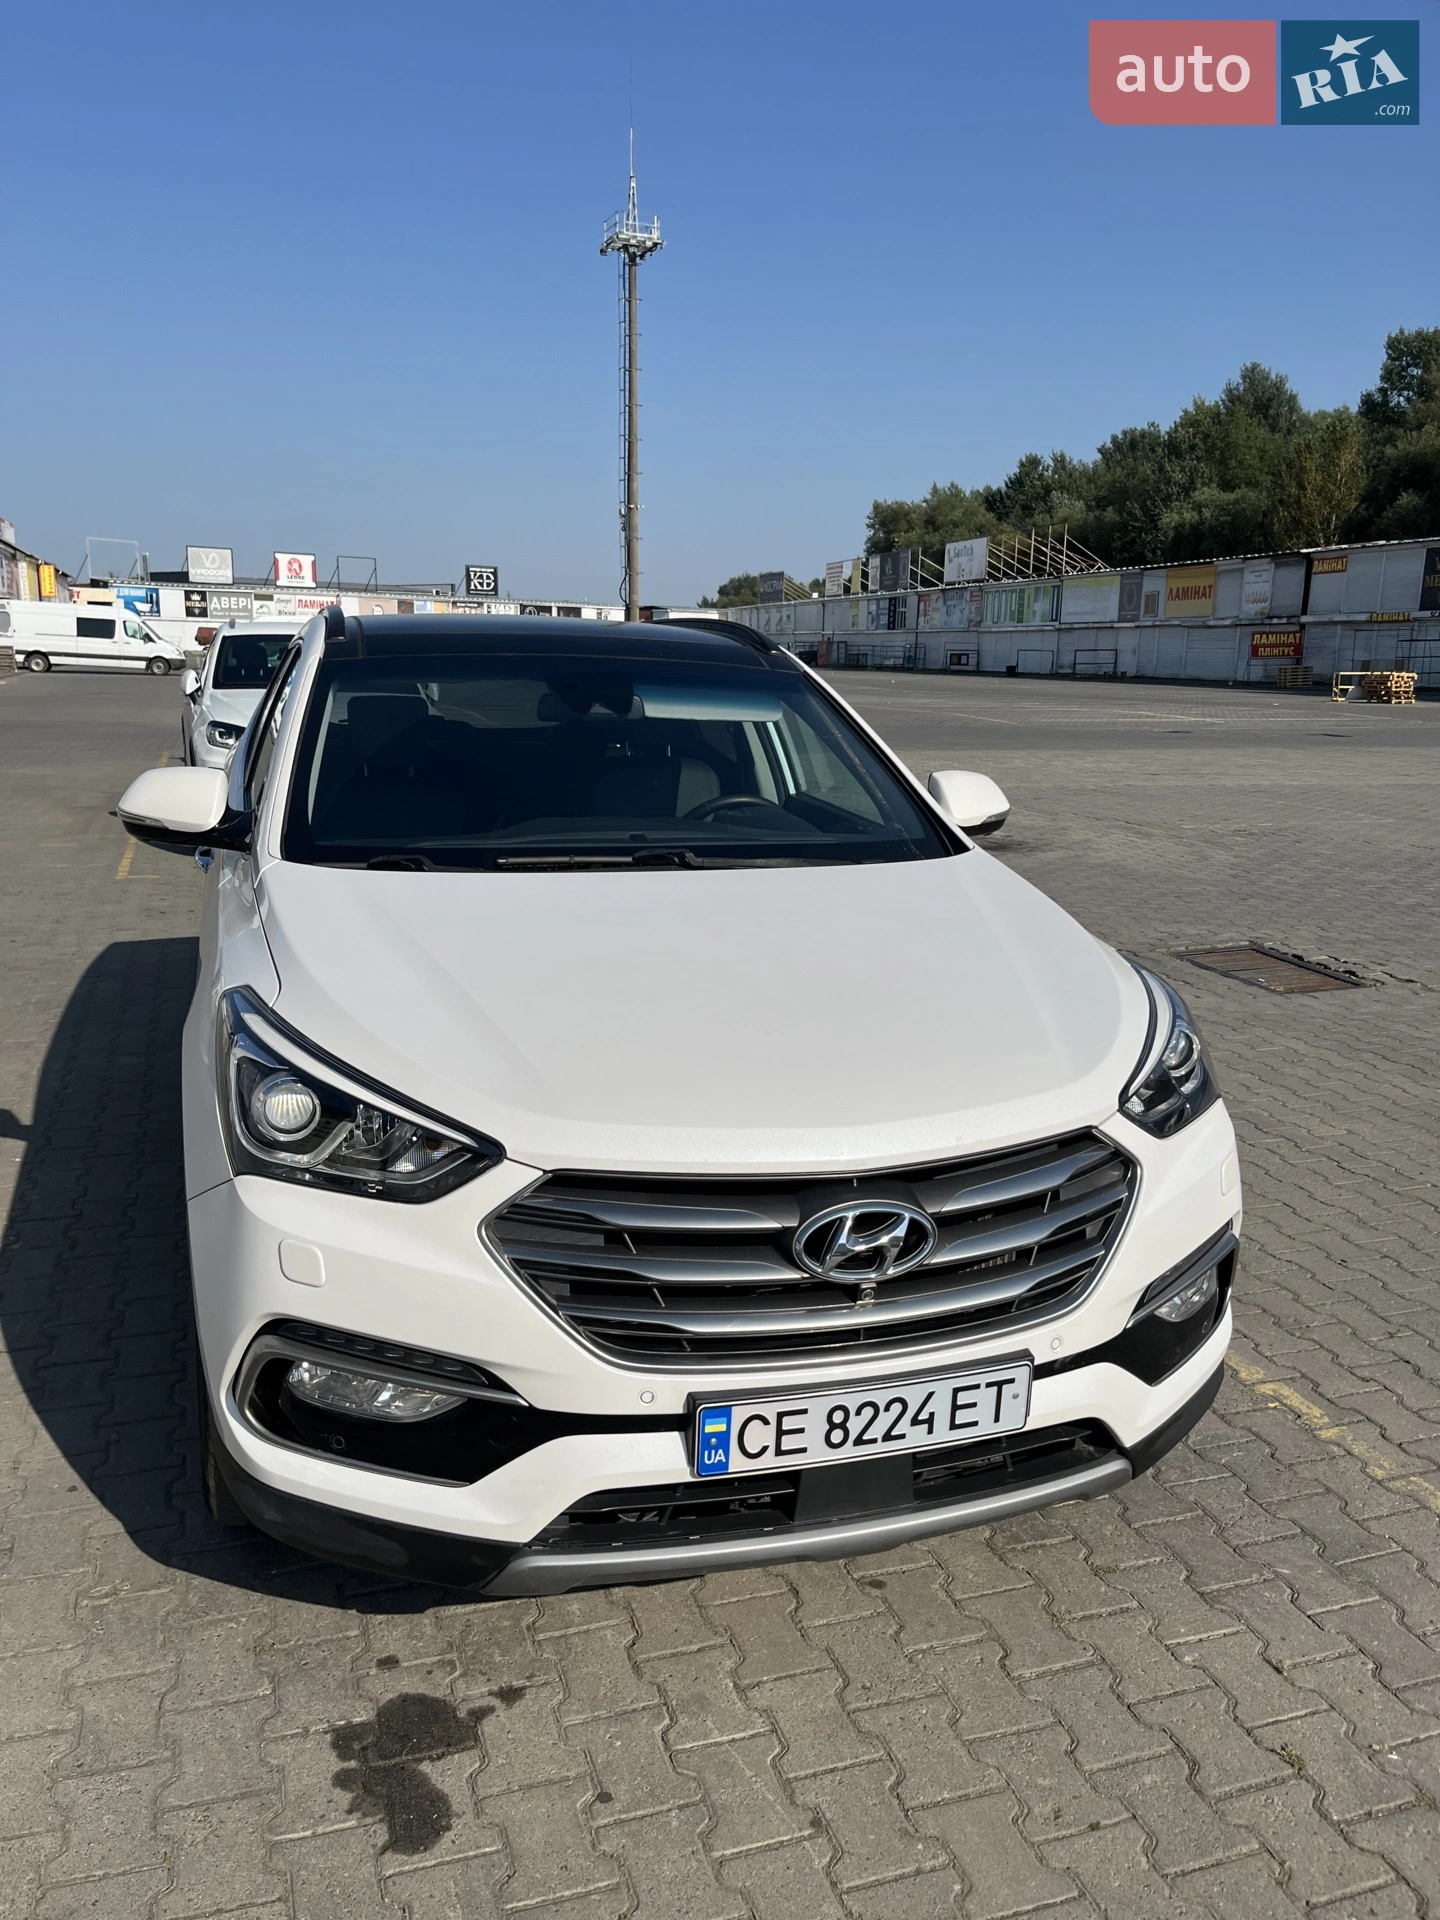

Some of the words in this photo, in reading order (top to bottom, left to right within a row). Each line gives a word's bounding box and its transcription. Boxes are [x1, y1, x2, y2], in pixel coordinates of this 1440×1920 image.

[1312, 558, 1347, 573] ЛАМІНАТ
[1167, 584, 1213, 602] ЛАМІНАТ
[210, 596, 251, 610] ДВЕРІ
[1371, 612, 1409, 622] ЛАМІНАТ
[1252, 633, 1300, 645] ЛАМІНАТ
[1258, 646, 1295, 656] ПЛІНТУС
[737, 1408, 809, 1460] CE
[824, 1390, 936, 1450] 8224
[949, 1377, 1016, 1432] ET
[704, 1449, 726, 1465] UA
